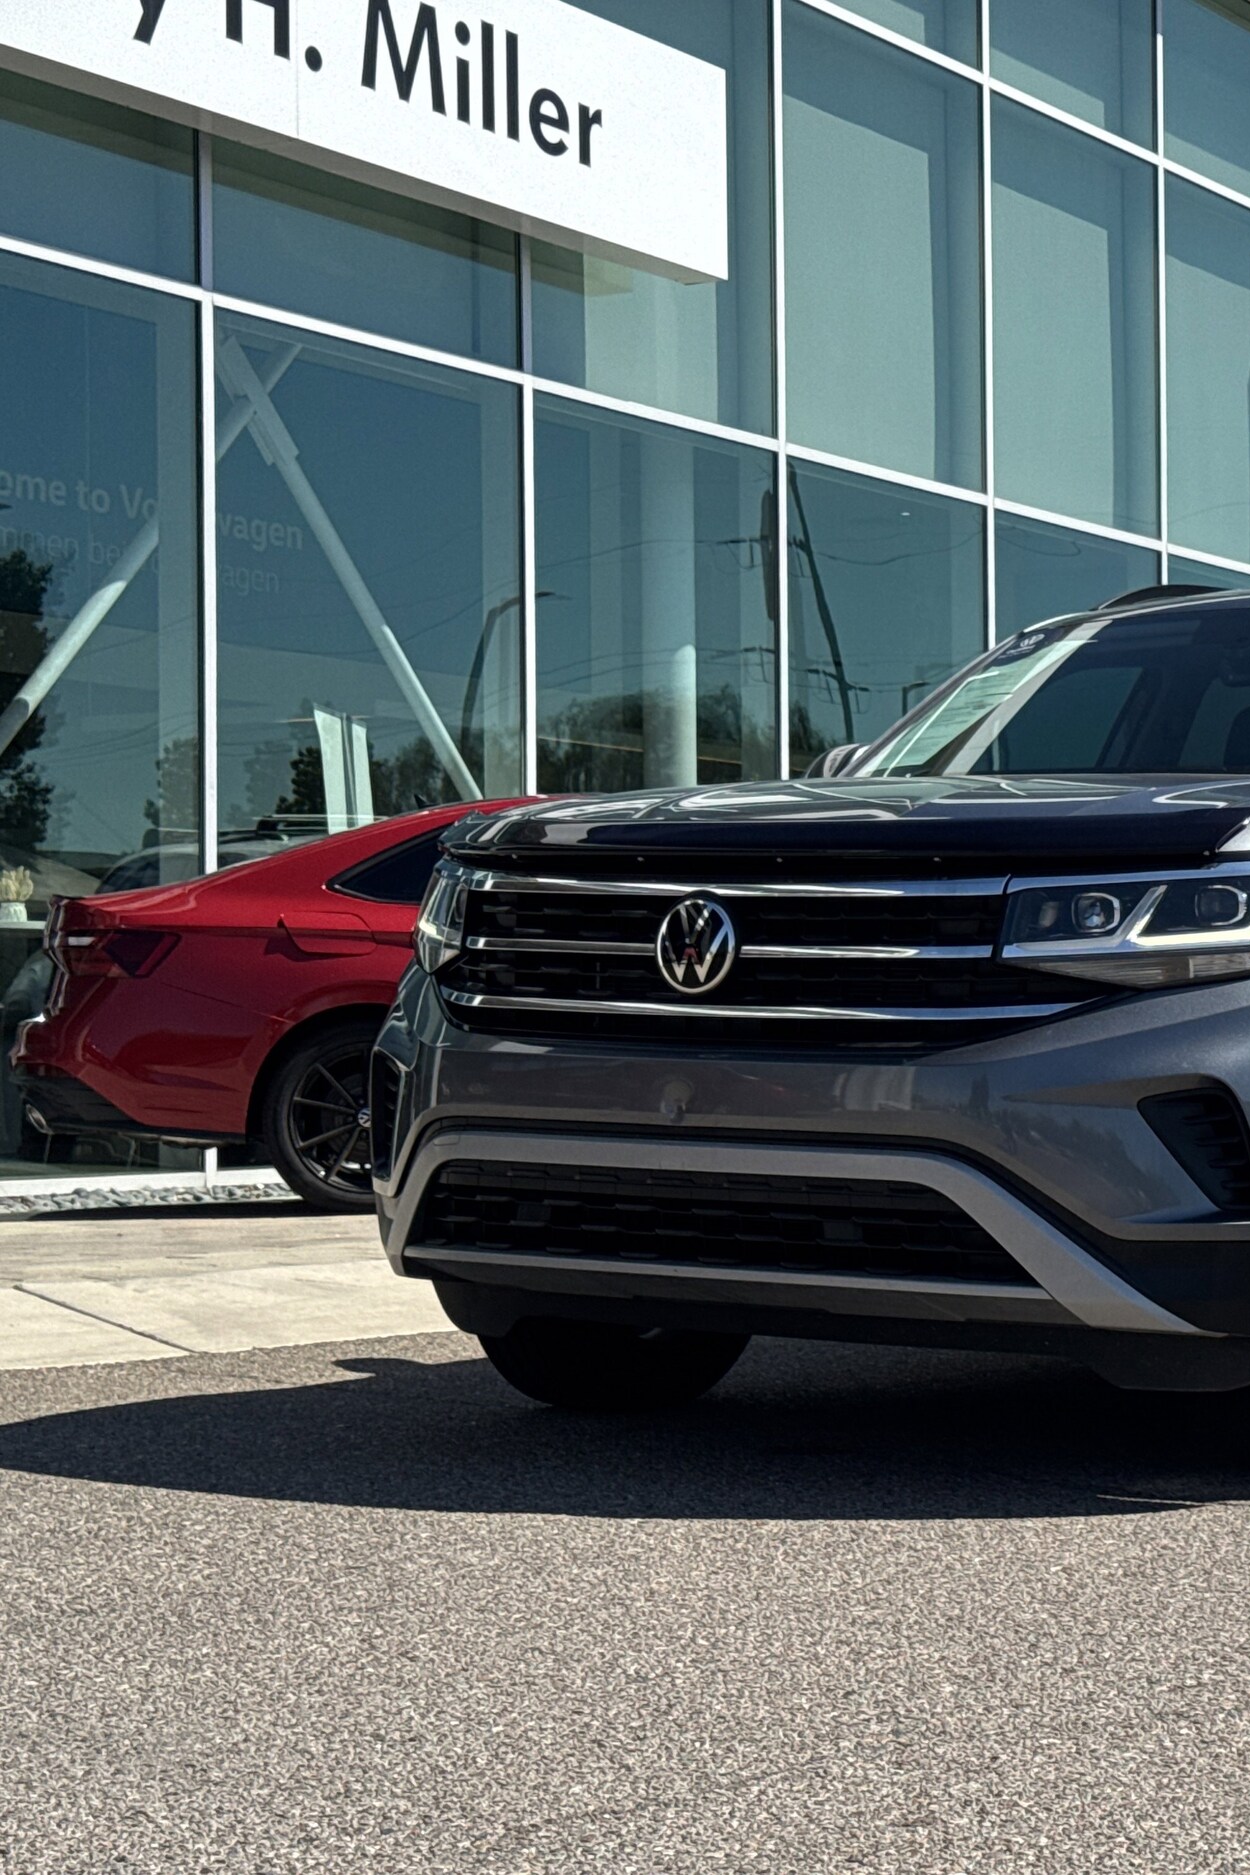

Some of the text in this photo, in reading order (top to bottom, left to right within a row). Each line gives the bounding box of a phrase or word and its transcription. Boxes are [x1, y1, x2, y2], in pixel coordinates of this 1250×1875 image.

[360, 0, 602, 168] Miller
[75, 478, 111, 514] to
[657, 899, 736, 991] VW
